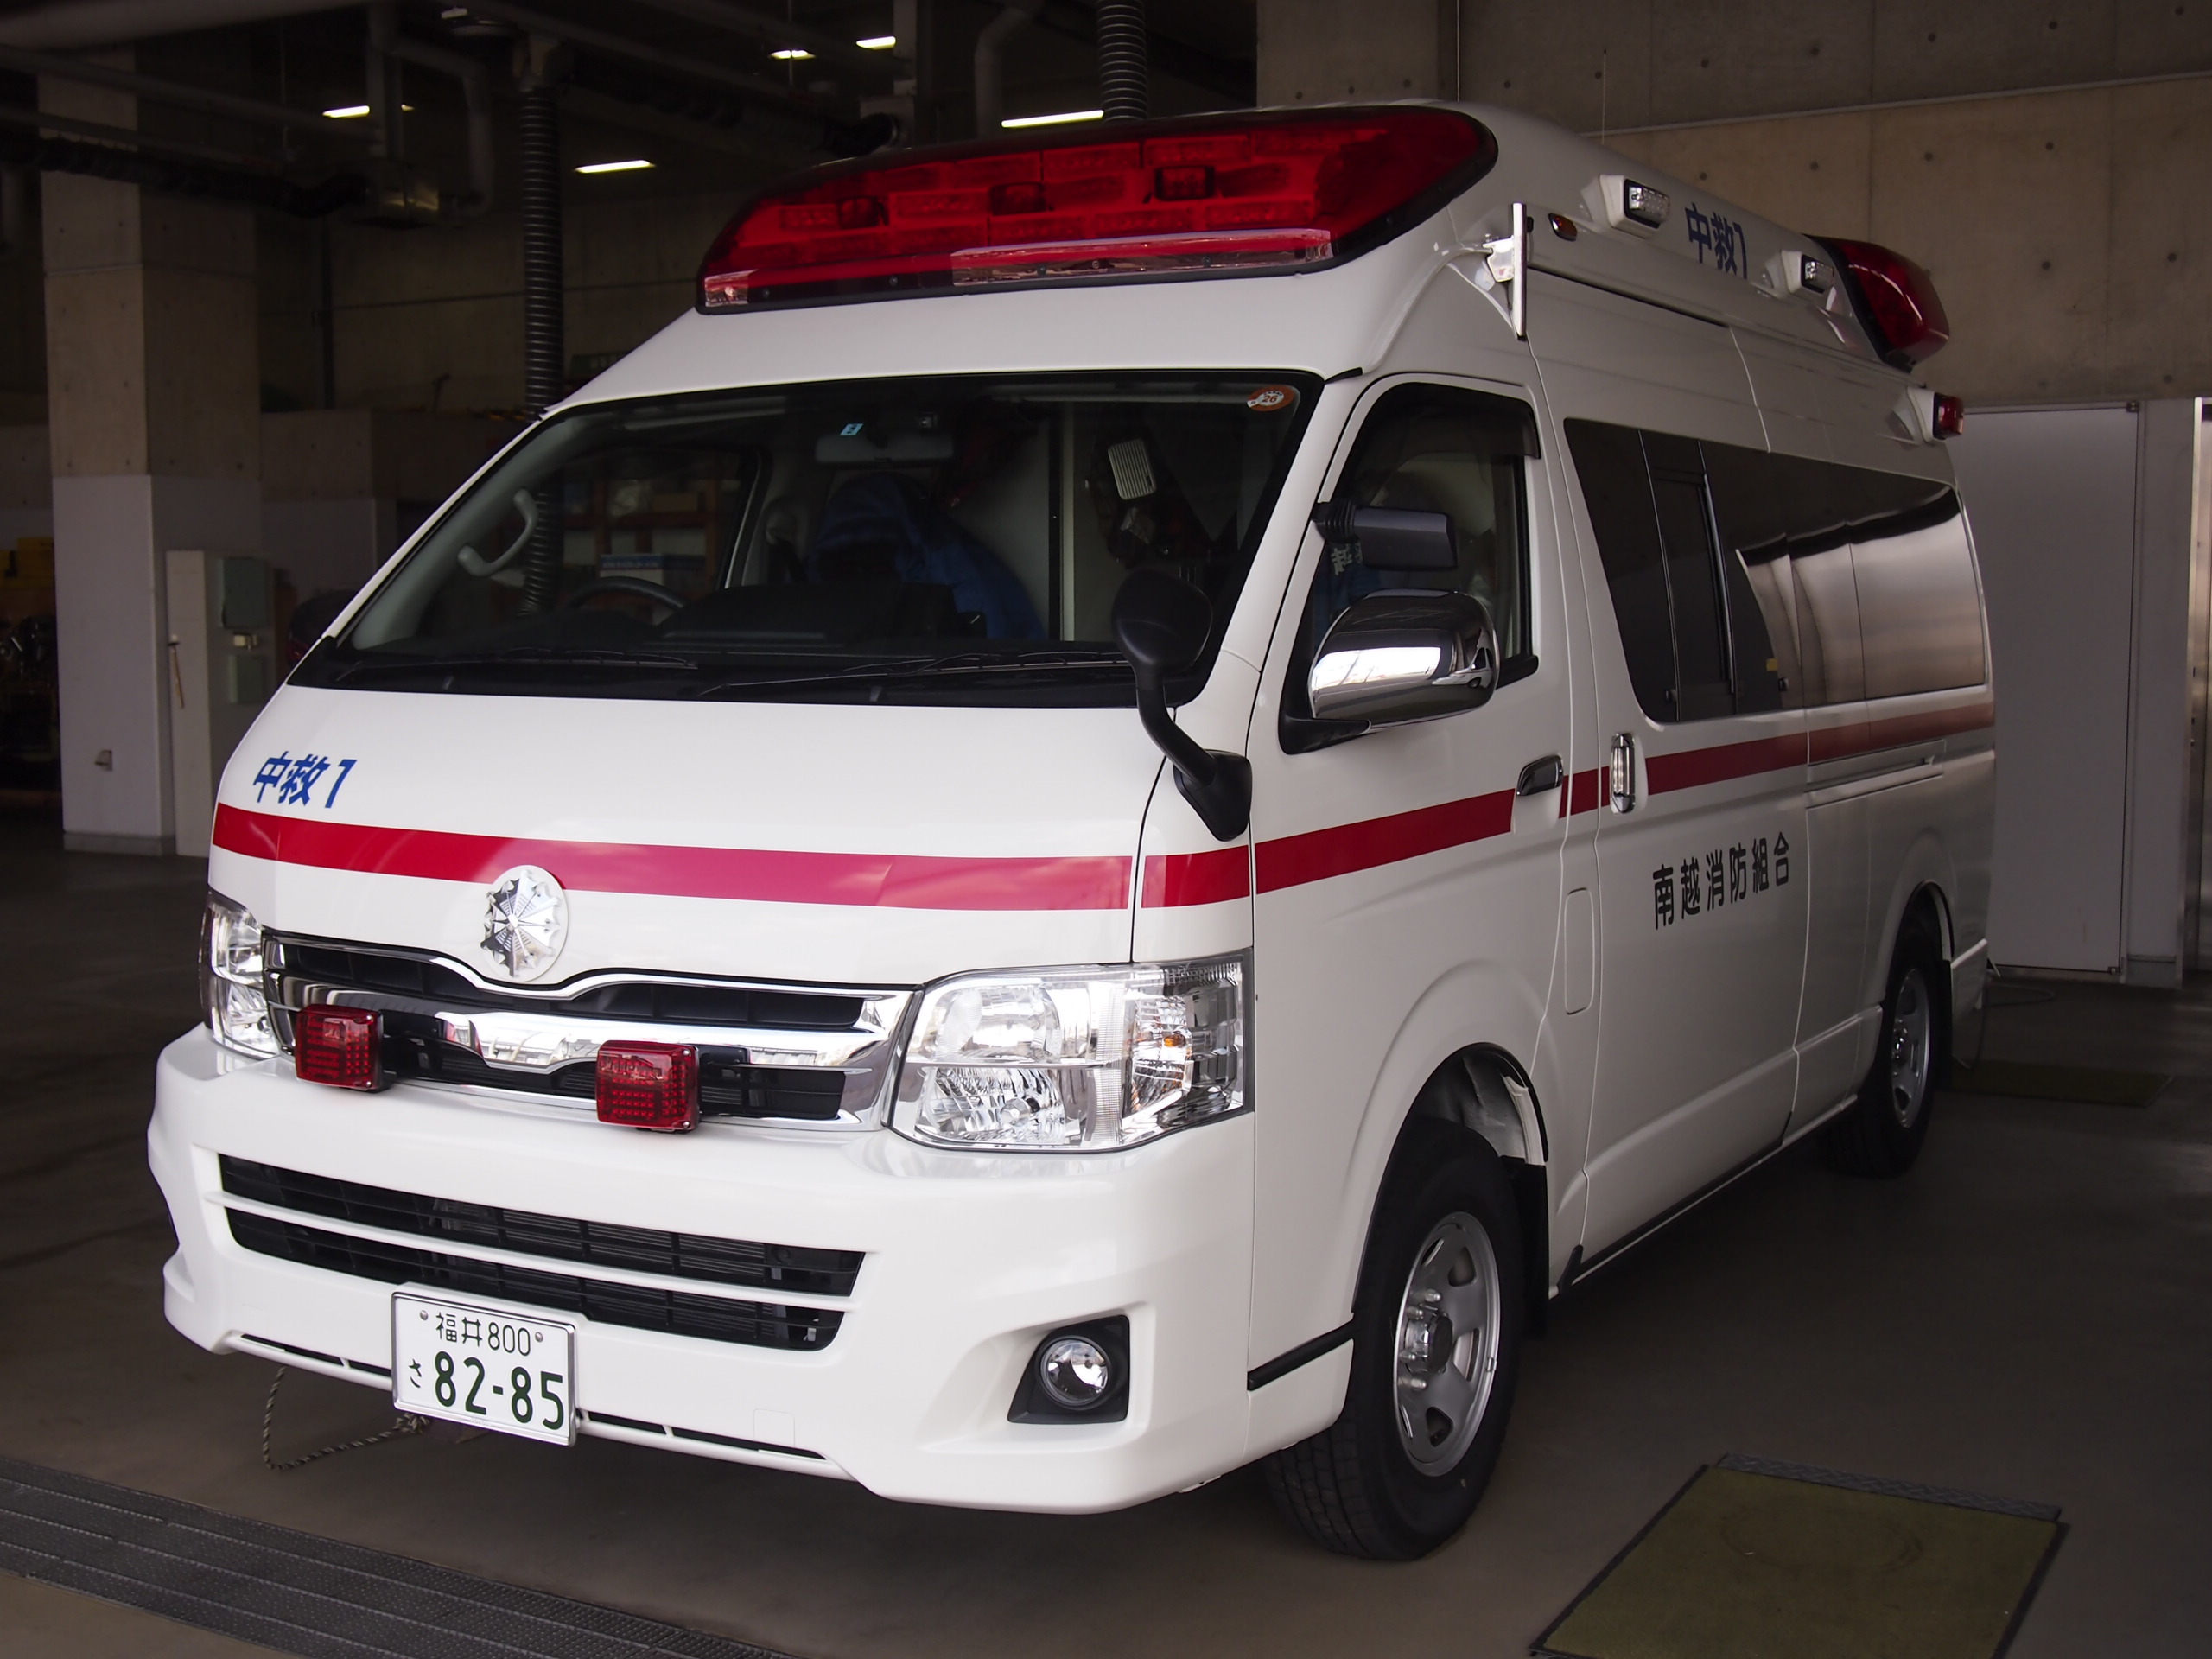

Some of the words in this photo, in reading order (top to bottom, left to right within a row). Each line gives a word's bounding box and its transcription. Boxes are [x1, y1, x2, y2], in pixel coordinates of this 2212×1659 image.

[1685, 202, 1747, 280] 中救1
[252, 751, 358, 809] 中救1
[1652, 831, 1789, 931] 南越消防組合
[408, 1358, 423, 1389] さ
[435, 1351, 564, 1430] 82-85
